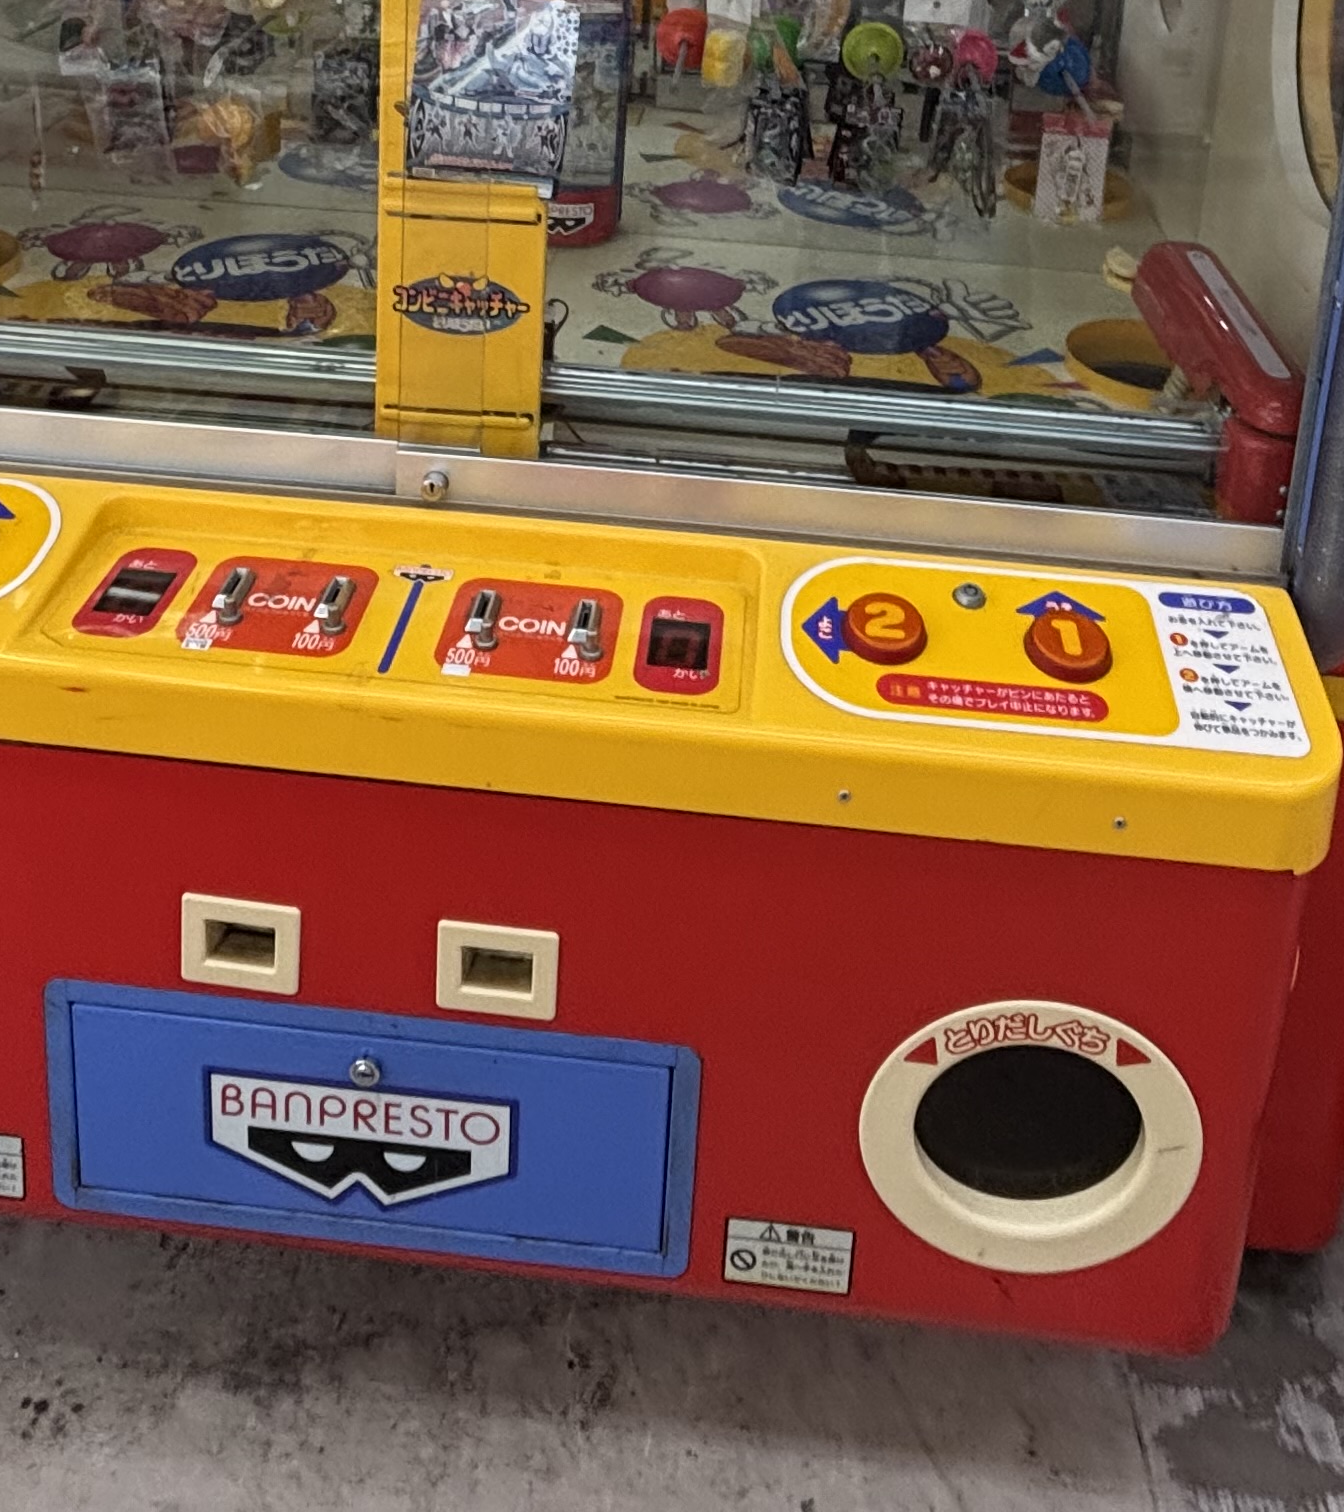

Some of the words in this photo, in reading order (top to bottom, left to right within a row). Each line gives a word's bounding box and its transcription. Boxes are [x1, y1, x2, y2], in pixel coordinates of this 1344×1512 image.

[550, 203, 594, 216] PRESTO
[247, 592, 317, 612] COIN
[498, 615, 567, 638] COIN
[863, 601, 907, 639] 2
[291, 631, 334, 652] 100円
[1050, 618, 1084, 656] 1
[553, 657, 597, 678] 100円
[943, 1012, 1111, 1056] とりだしぐち
[219, 1083, 502, 1147] BANPRESTO
